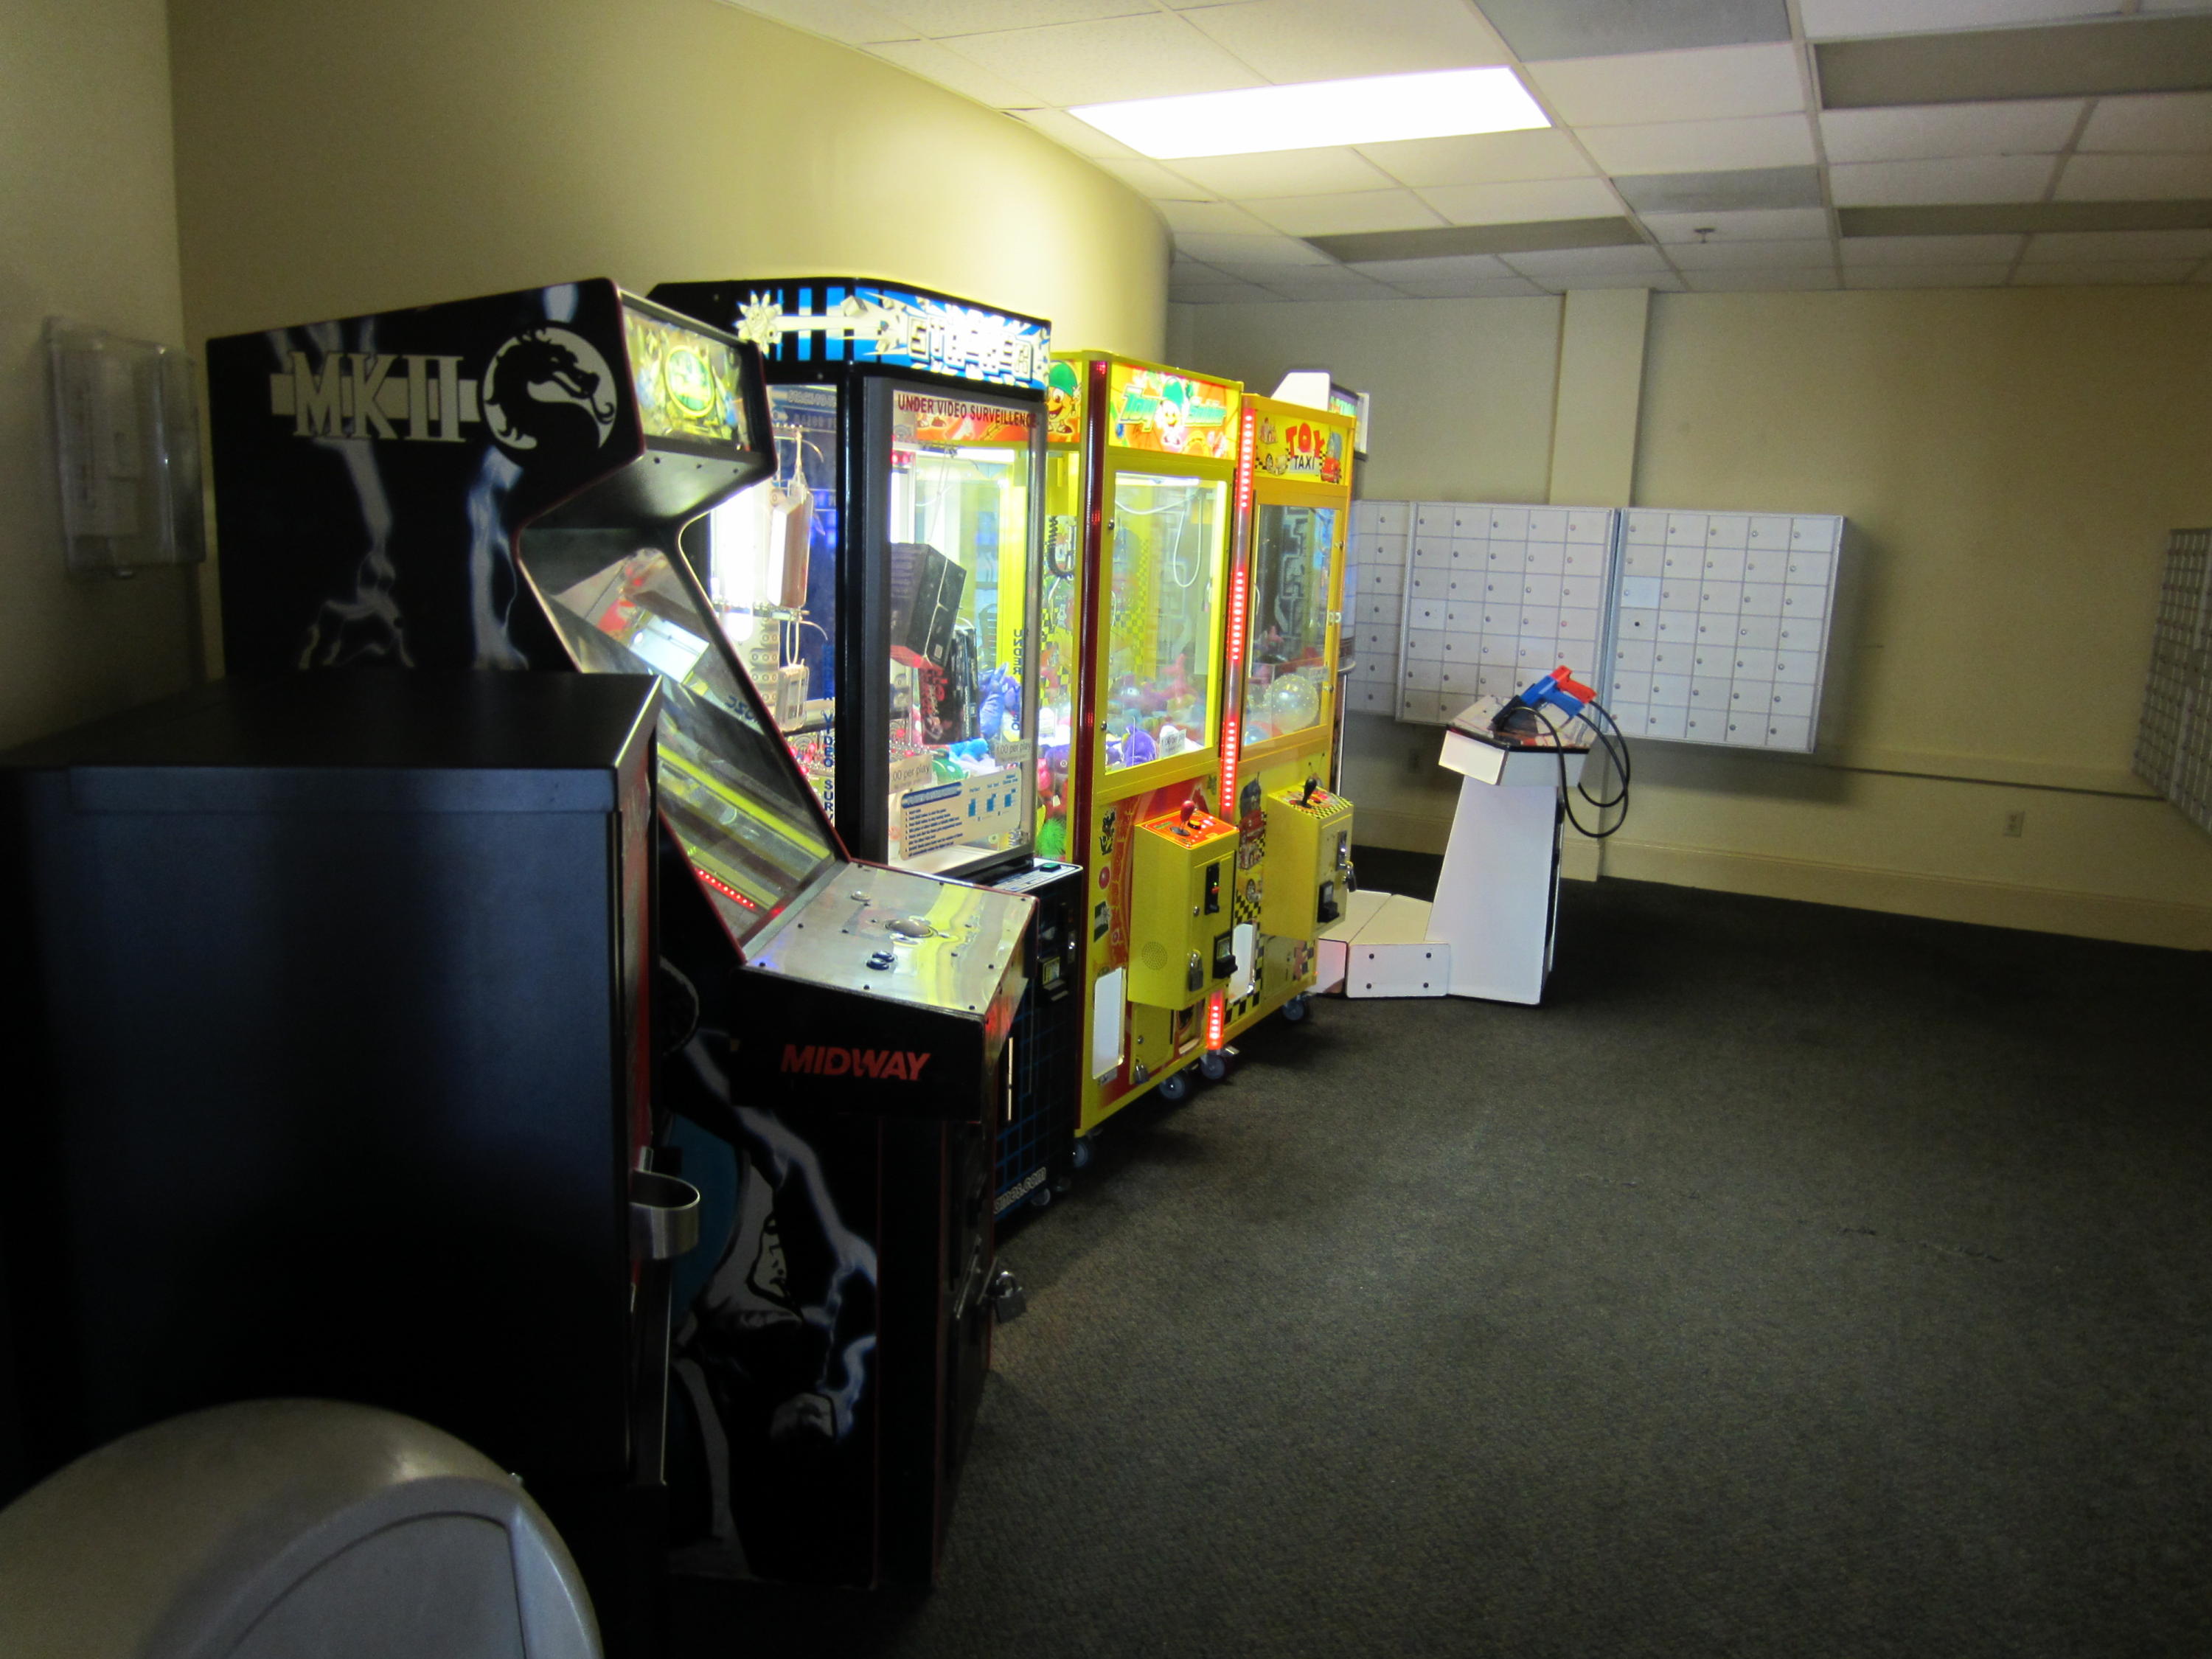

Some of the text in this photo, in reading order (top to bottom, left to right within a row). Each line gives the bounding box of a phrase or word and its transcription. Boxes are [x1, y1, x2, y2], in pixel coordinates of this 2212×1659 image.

[898, 394, 1037, 428] UNDER VIDEO SURVEILLENCE
[1286, 422, 1325, 459] TOY
[1294, 455, 1315, 470] TAXI
[916, 763, 930, 776] play
[780, 1044, 931, 1080] MIDWAY
